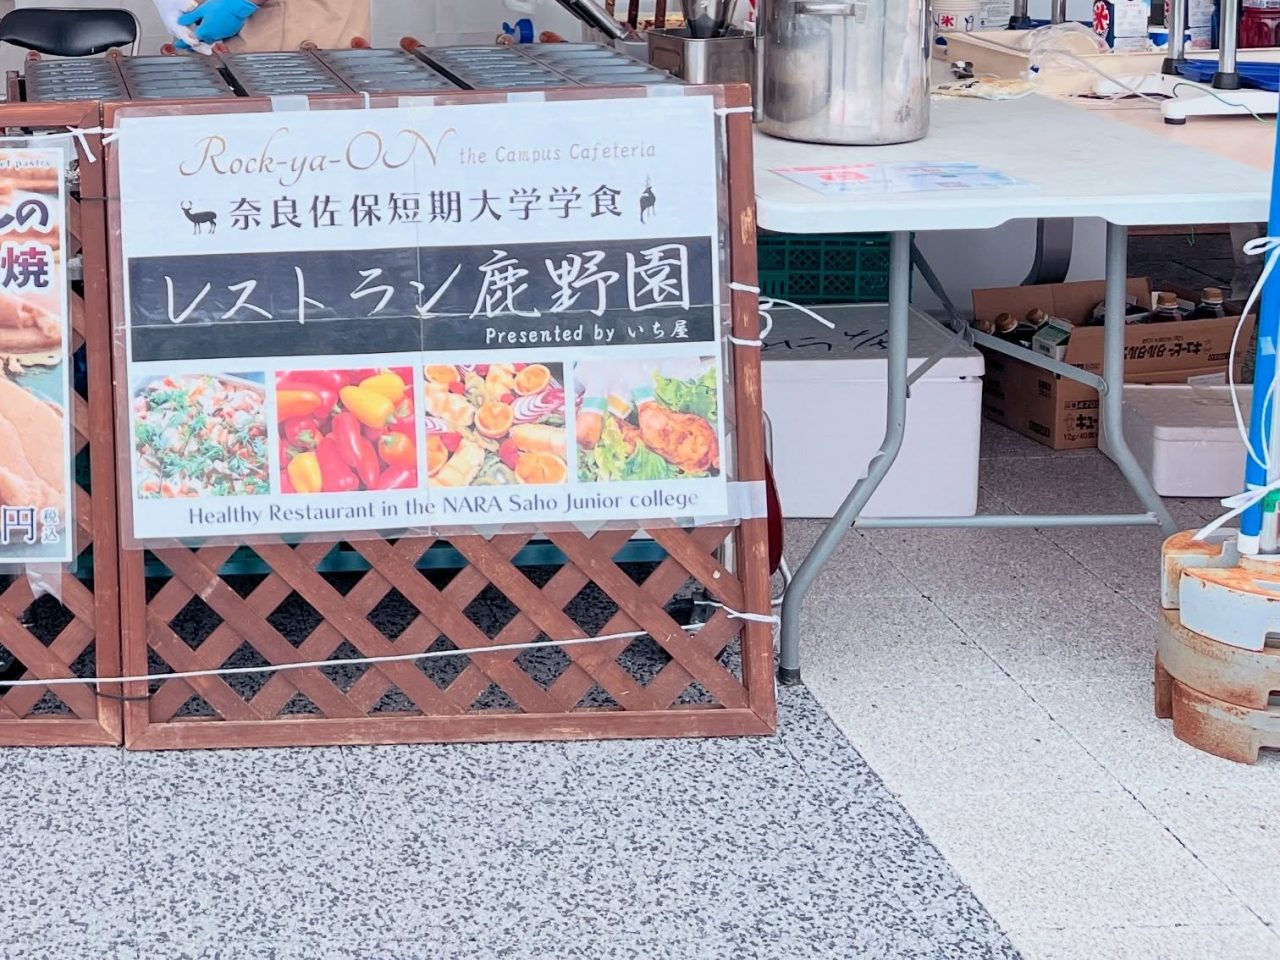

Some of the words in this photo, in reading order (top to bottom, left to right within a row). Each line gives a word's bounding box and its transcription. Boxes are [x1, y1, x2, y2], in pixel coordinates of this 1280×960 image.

[460, 147, 486, 164] the
[496, 146, 561, 167] Campus
[570, 141, 656, 161] Cafeteria
[230, 184, 623, 230] 奈良佐保短期大学学食
[165, 243, 690, 324] レストラン鹿野園
[486, 326, 584, 344] Presented
[594, 324, 615, 343] by
[627, 320, 690, 339] いち屋
[189, 505, 262, 526] Healthy
[269, 501, 375, 522] Restaurant
[381, 499, 400, 517] in
[407, 497, 436, 516] the
[442, 495, 502, 515] NARA
[509, 492, 557, 513] Saho
[563, 492, 624, 514] Junior
[630, 488, 700, 511] college
